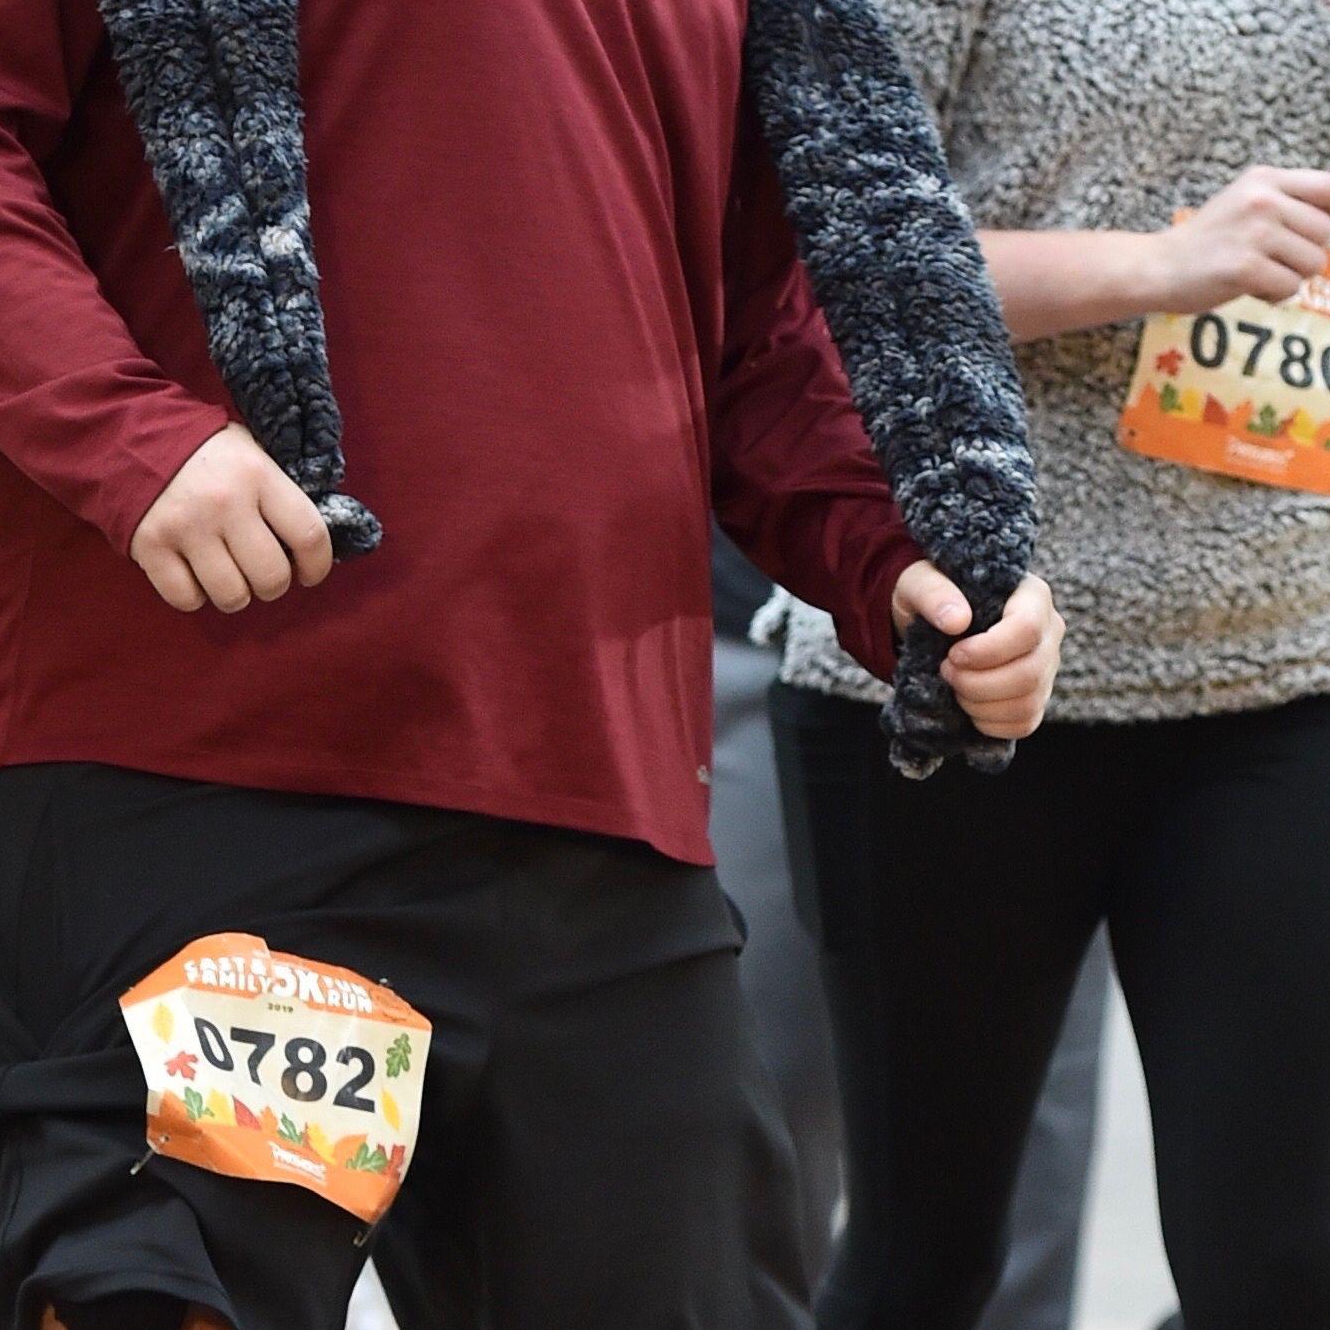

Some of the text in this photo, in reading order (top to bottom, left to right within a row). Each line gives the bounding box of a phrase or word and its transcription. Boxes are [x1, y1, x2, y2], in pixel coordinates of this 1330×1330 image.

[271, 964, 326, 1004] 5K
[327, 987, 373, 1014] RUN
[193, 1016, 376, 1114] 0782
